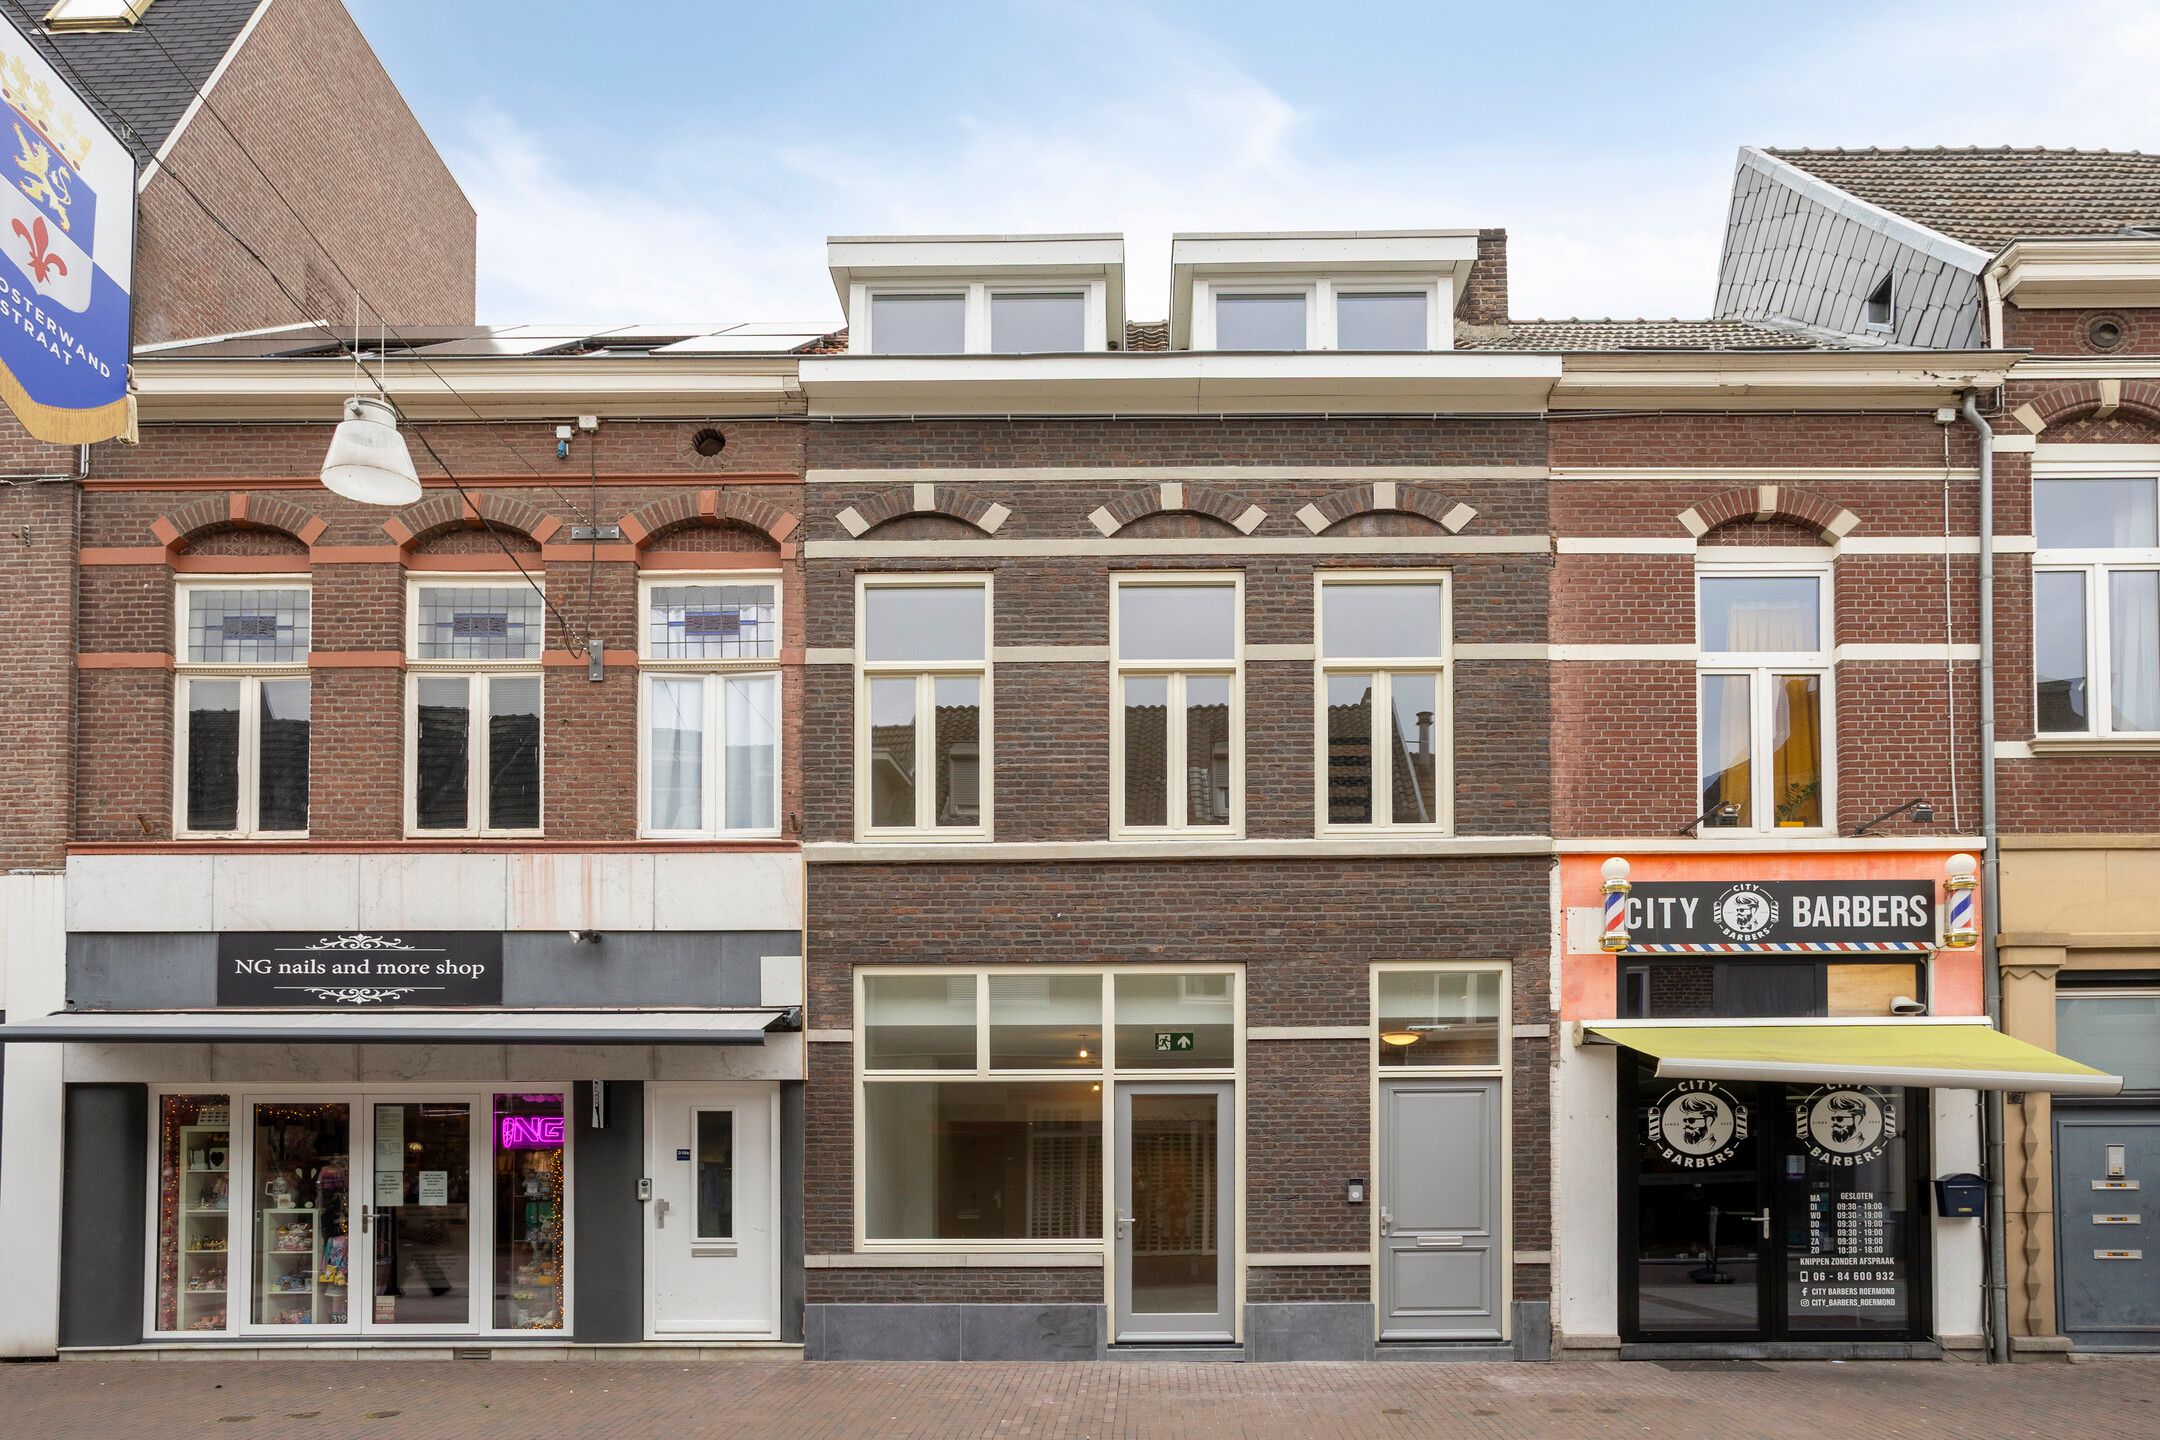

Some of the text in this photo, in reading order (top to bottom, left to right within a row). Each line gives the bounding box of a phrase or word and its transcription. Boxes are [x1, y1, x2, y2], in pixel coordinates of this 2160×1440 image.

[0, 299, 72, 367] STRAAT
[1733, 883, 1760, 892] CITY
[1624, 894, 1928, 929] CITY BARBERS
[1722, 927, 1771, 942] BARBERS
[235, 959, 485, 980] NG nails and more shop
[1677, 1080, 1718, 1092] CITY
[1662, 1147, 1735, 1168] BARBERS
[1810, 1146, 1883, 1167] BARBERS
[1809, 1192, 1874, 1202] MA GESLOTEN
[1810, 1203, 1818, 1211] DI
[1836, 1203, 1857, 1211] 09:30
[1863, 1202, 1883, 1210] 19:00
[1863, 1211, 1883, 1219] 19:00
[1810, 1220, 1820, 1228] DO
[1837, 1220, 1857, 1228] 09:30
[1810, 1229, 1820, 1237] VR
[1863, 1228, 1883, 1236] 19:00
[1864, 1237, 1883, 1245] 19:00
[1810, 1246, 1820, 1254] ZO
[1837, 1246, 1857, 1254] 10:30
[1800, 1257, 1895, 1266] KNIPPEN ZONDER AFSPRAAK
[1813, 1272, 1826, 1281] 06
[1837, 1272, 1850, 1281] 84
[1853, 1271, 1872, 1281] 600
[1875, 1271, 1895, 1281] 932
[1811, 1287, 1895, 1295] CITY BARBERS ROERMOND
[1811, 1298, 1896, 1307] CITY_BARBERS_ROERMOND
[331, 1314, 347, 1323] 319
